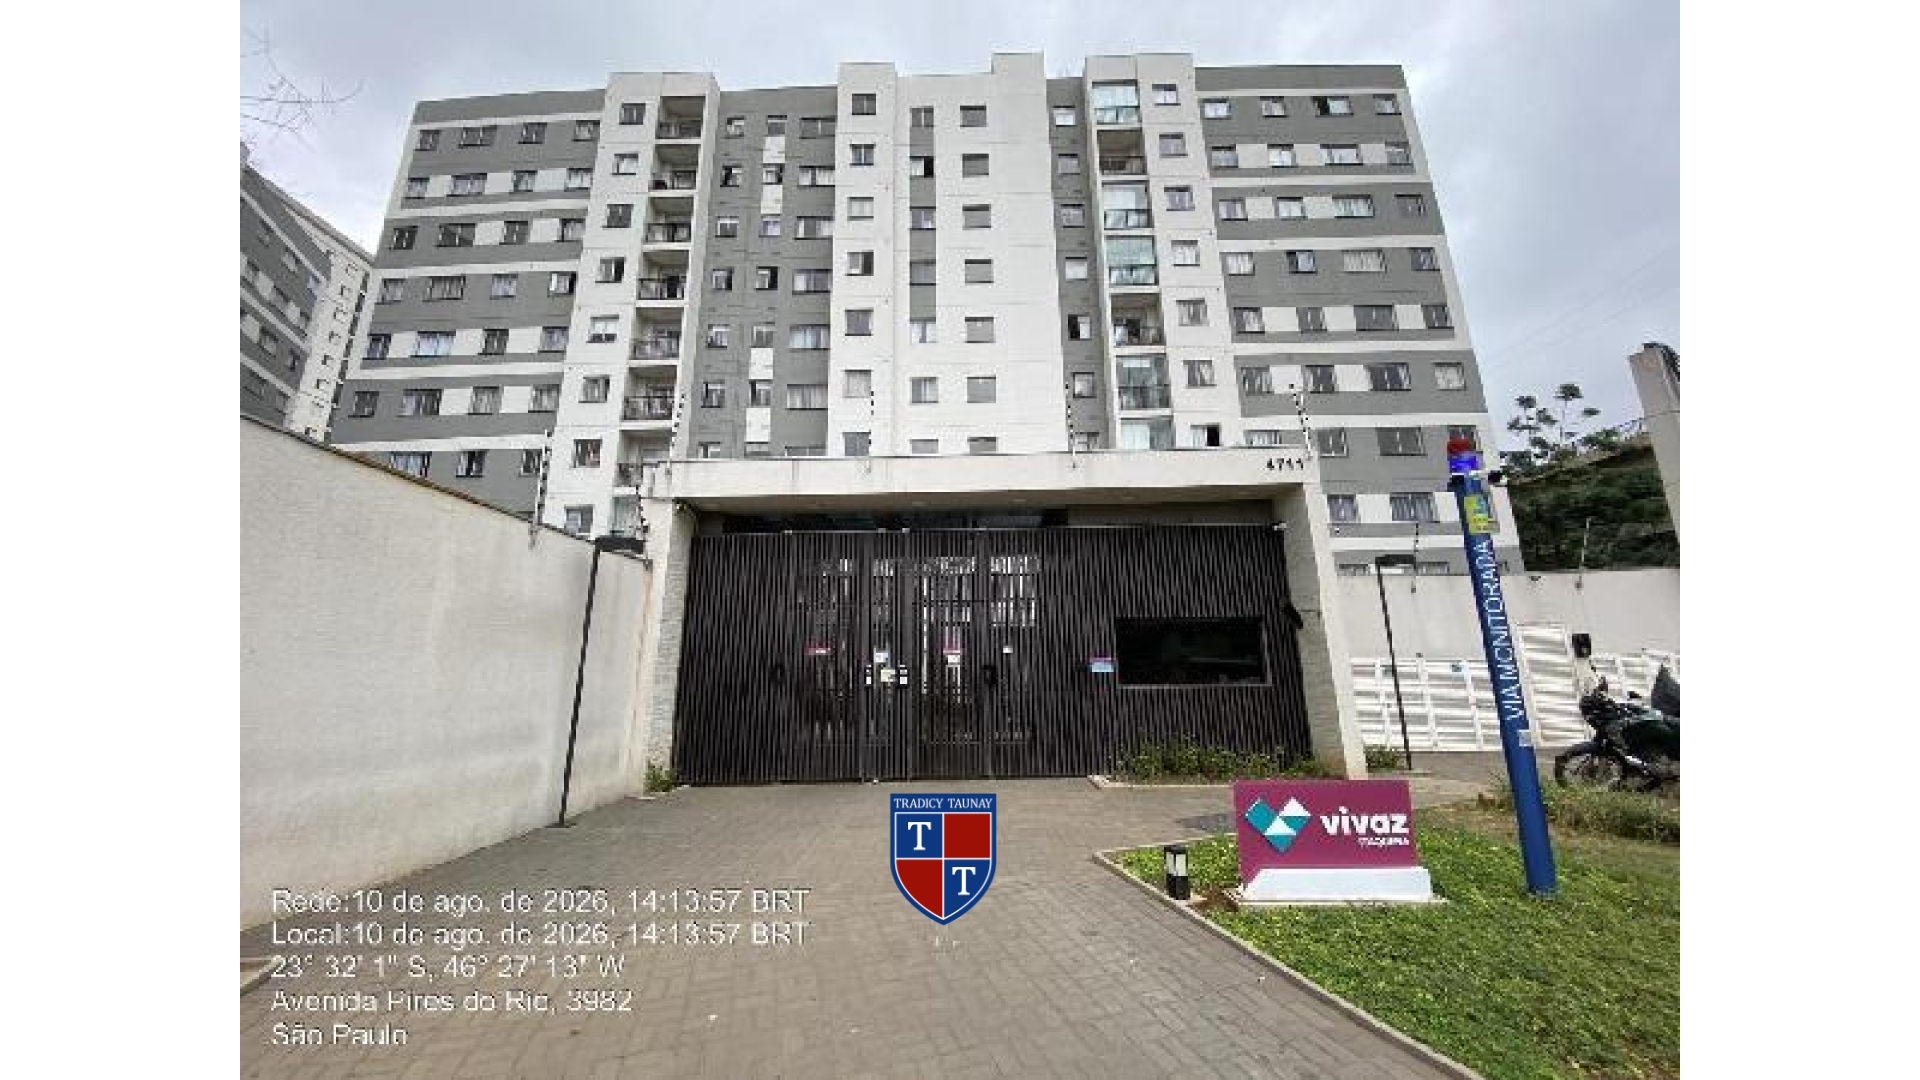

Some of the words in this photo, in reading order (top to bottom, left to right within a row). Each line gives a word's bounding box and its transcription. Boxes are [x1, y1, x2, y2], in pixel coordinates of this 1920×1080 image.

[1473, 540, 1518, 681] MONITORADA
[1501, 683, 1524, 721] VIA
[1319, 806, 1410, 836] vivaz
